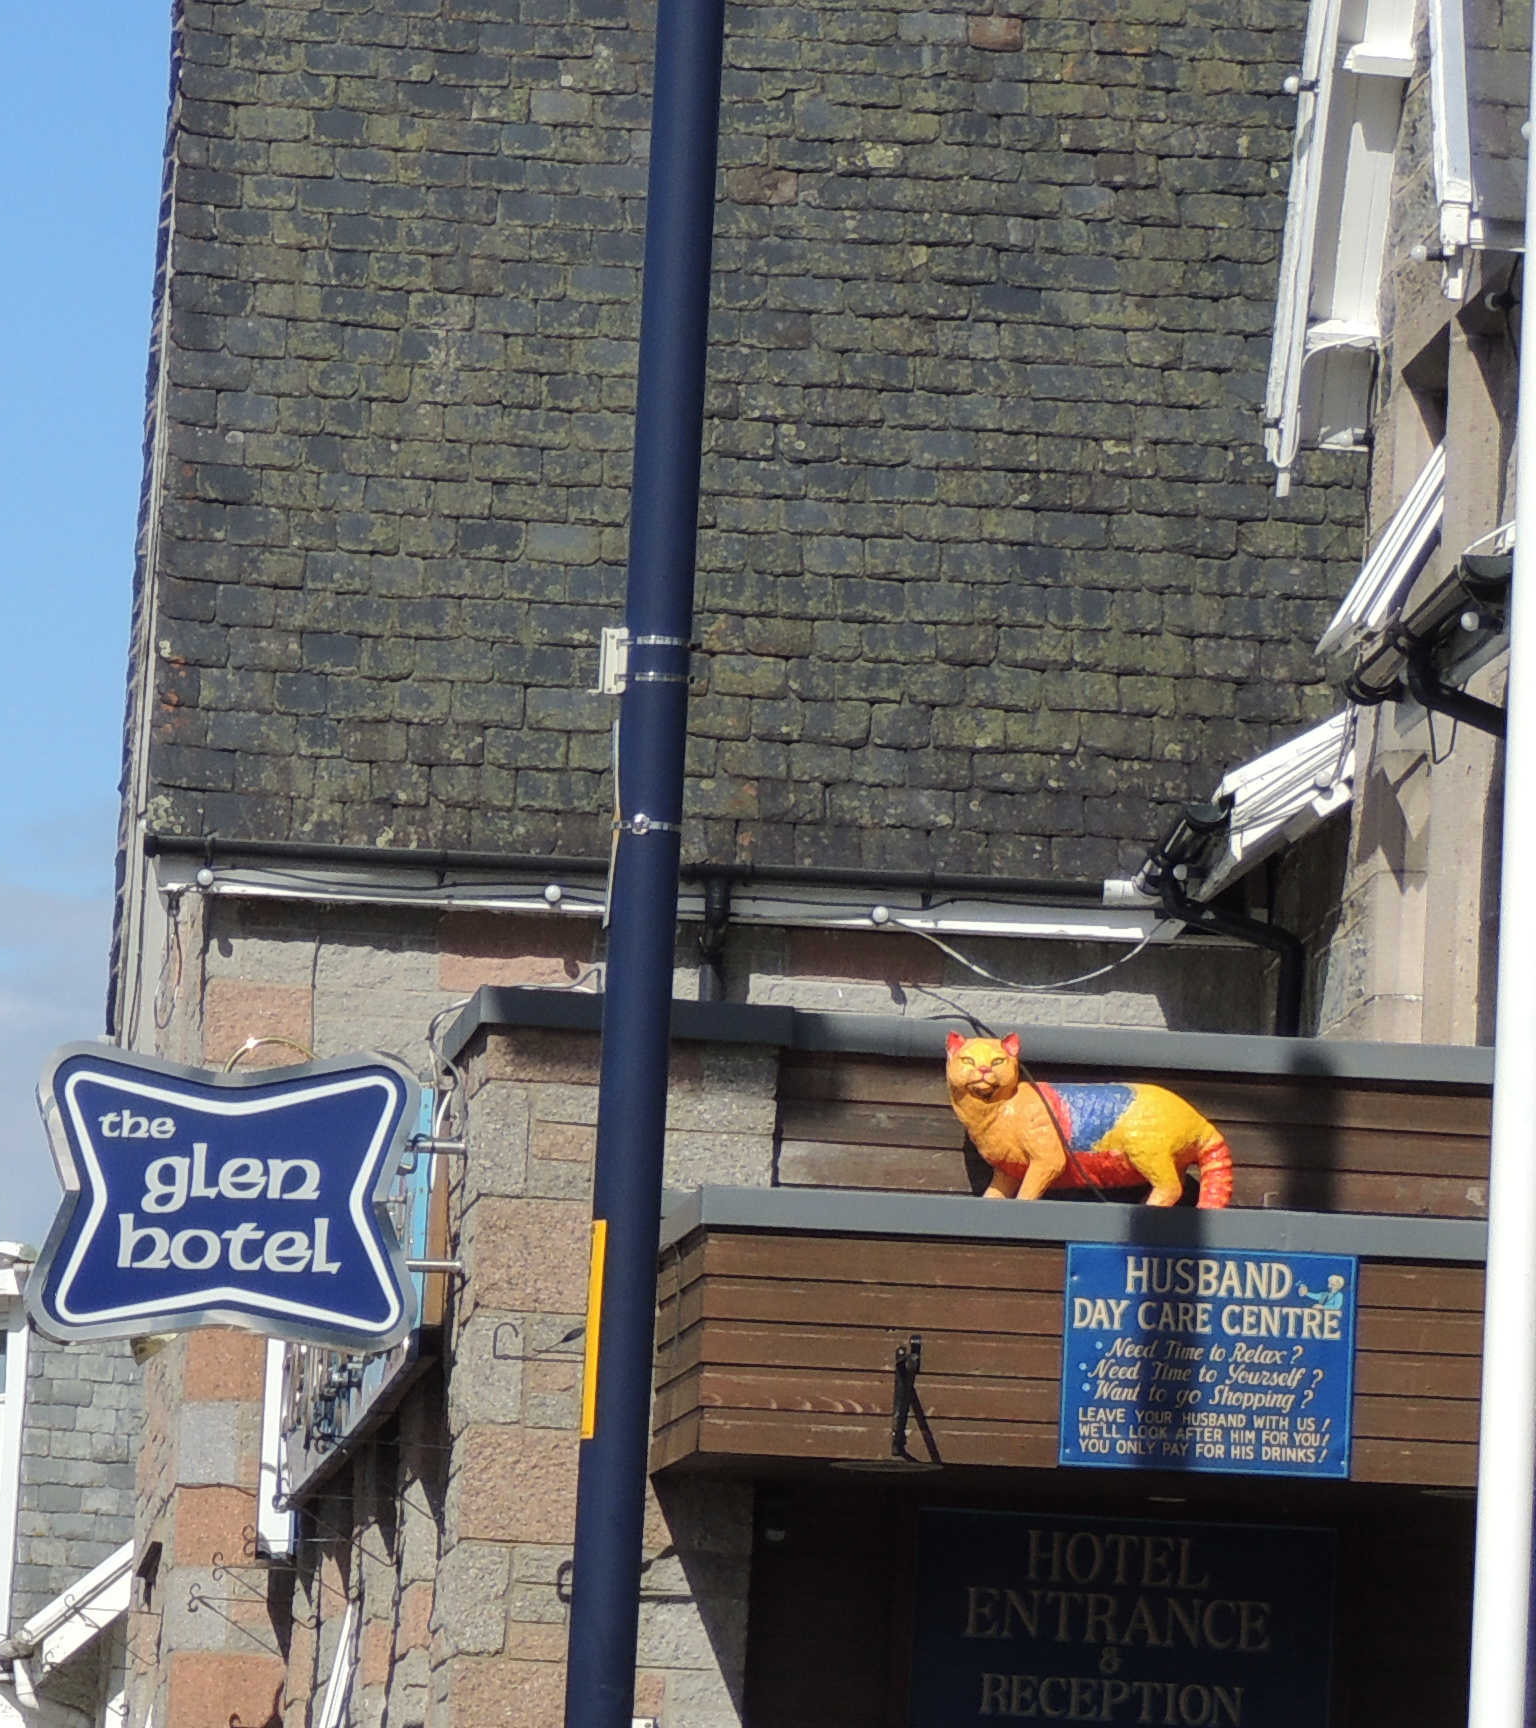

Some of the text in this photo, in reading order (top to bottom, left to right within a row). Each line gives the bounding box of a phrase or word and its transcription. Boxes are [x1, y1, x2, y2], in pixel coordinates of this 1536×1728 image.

[98, 1109, 176, 1139] the
[140, 1142, 321, 1213] glen
[117, 1213, 342, 1274] hotel
[1125, 1256, 1293, 1299] HUSBAND
[1073, 1298, 1342, 1340] DAY CARE CENTRE
[1105, 1338, 1157, 1358] Need
[1163, 1340, 1202, 1361] Time
[1209, 1343, 1225, 1361] to
[1229, 1343, 1287, 1365] Relax
[1087, 1359, 1141, 1379] Need
[1151, 1361, 1192, 1382] Time
[1198, 1364, 1217, 1383] to
[1225, 1366, 1306, 1390] Yourself
[1093, 1380, 1141, 1402] Want
[1148, 1383, 1167, 1402] to
[1177, 1389, 1201, 1409] go
[1209, 1384, 1296, 1413] Shopping
[1078, 1407, 1126, 1422] LEAVE
[1135, 1409, 1172, 1424] YOUR
[1182, 1412, 1246, 1428] HUSBAND
[1253, 1414, 1289, 1430] WITH
[1296, 1417, 1316, 1431] US
[1078, 1423, 1121, 1438] WE'LL
[1129, 1424, 1168, 1440] LOOK
[1175, 1427, 1223, 1442] AFTER
[1230, 1429, 1256, 1443] HIM
[1262, 1430, 1288, 1445] FOR
[1079, 1438, 1110, 1454] YOU
[1115, 1440, 1155, 1455] ONLY
[1162, 1442, 1190, 1457] PAY
[1195, 1443, 1225, 1459] FOR
[1231, 1445, 1254, 1460] HIS
[1025, 1529, 1209, 1590] HOTEL
[961, 1586, 1272, 1653] ENTRANCE
[1098, 1646, 1123, 1674] &
[978, 1672, 1245, 1728] RECEPTION
